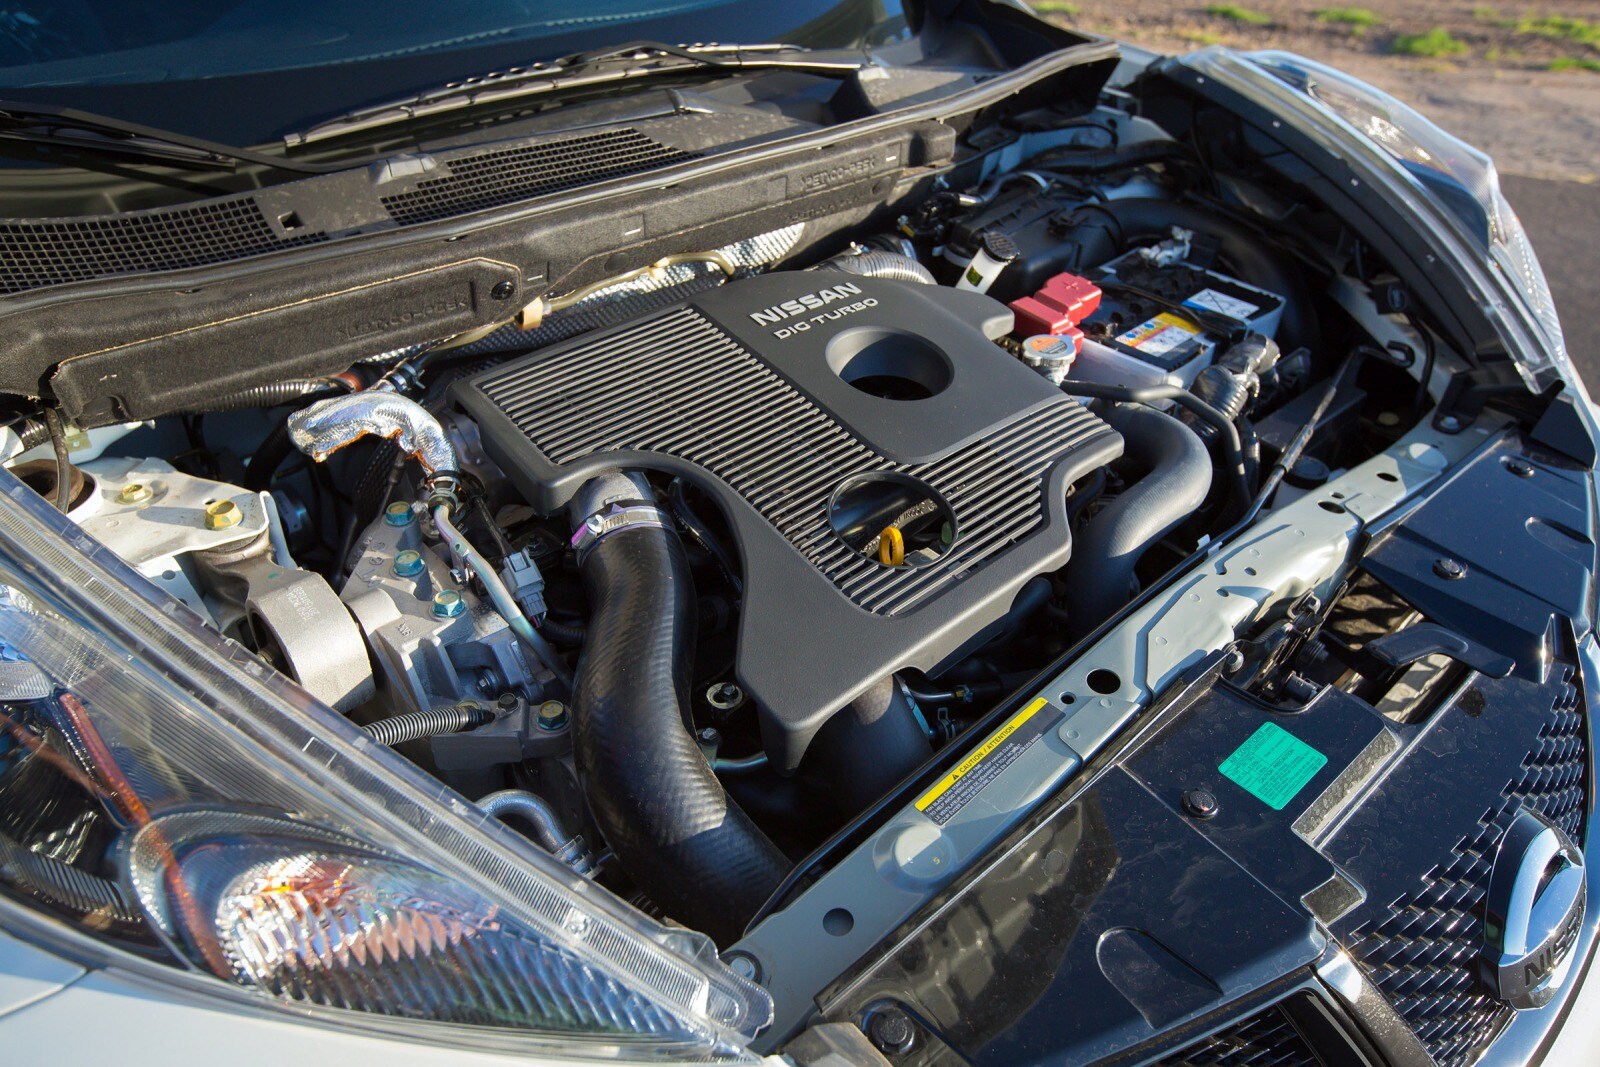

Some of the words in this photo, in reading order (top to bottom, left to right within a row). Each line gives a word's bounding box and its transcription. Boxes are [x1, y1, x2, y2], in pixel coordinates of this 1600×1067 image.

[750, 282, 861, 326] NISSAN
[774, 322, 811, 339] DIG
[810, 298, 878, 324] TURBO
[959, 752, 983, 772] CAUTION
[987, 725, 1015, 749] ATTENTION
[1524, 900, 1584, 989] NISSA
